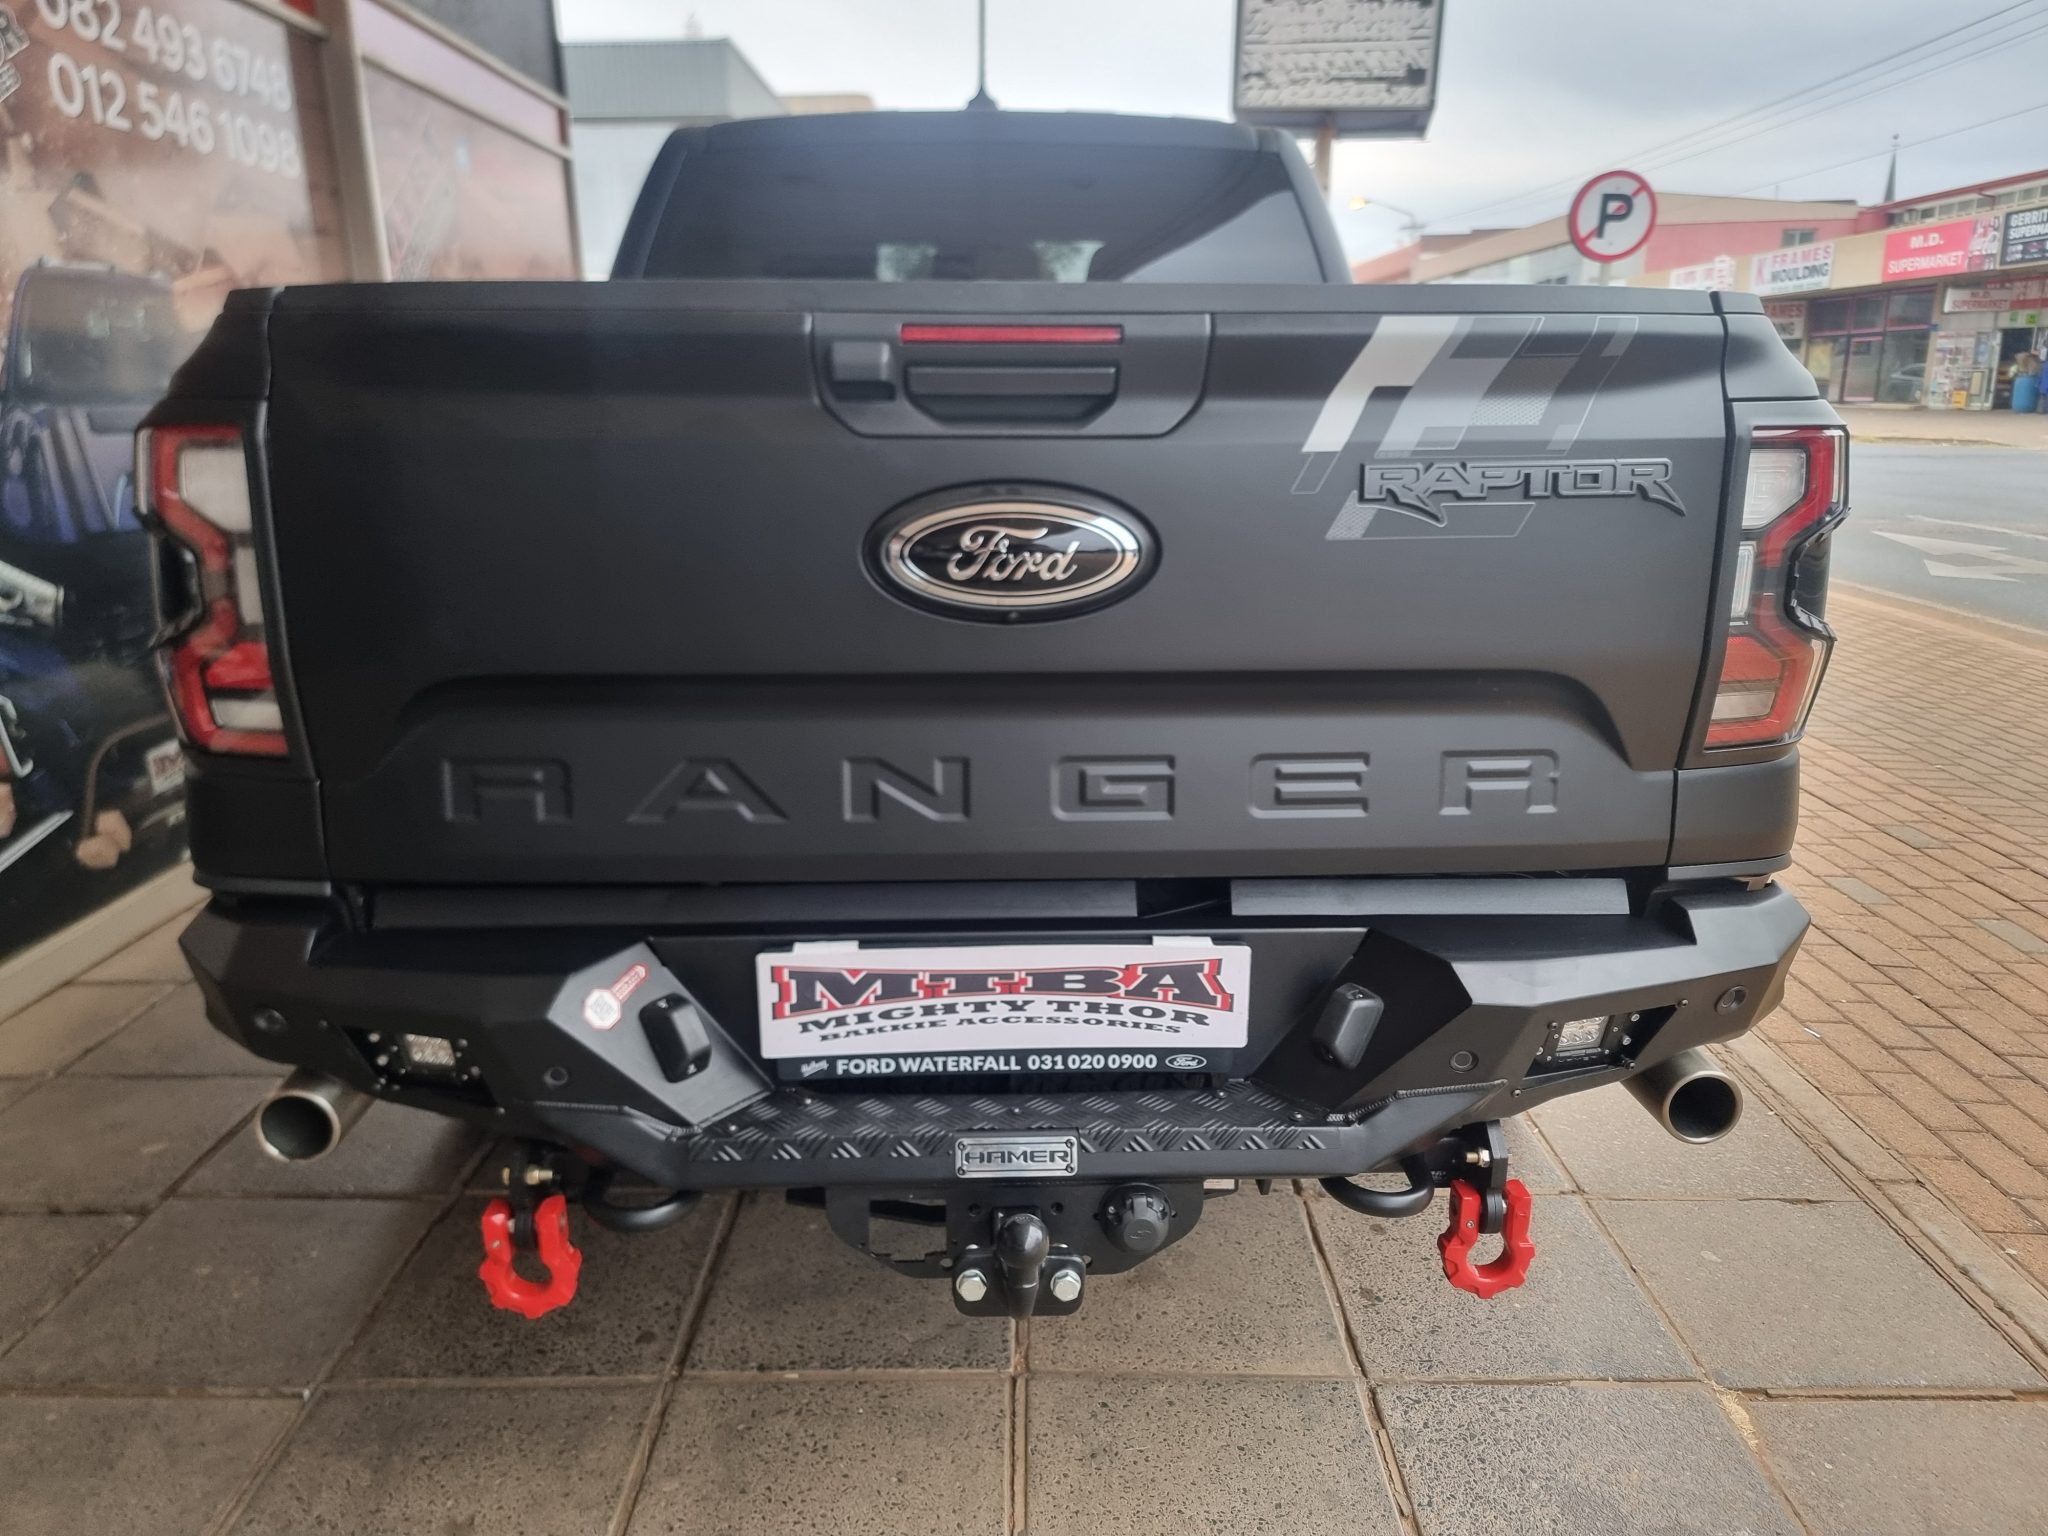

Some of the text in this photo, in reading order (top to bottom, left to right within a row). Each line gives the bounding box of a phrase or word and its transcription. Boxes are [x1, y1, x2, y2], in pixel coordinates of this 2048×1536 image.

[132, 5, 208, 81] 493
[212, 37, 293, 113] 6748
[47, 51, 133, 130] 012
[136, 80, 215, 155] 546
[218, 110, 300, 180] 1098
[1595, 193, 1634, 239] P
[1771, 244, 1832, 267] FRAMES
[1909, 232, 1944, 249] M.D.
[1771, 262, 1830, 283] MOULDING
[1887, 251, 1966, 274] SUPERMARKET
[1358, 458, 1687, 528] RAPTOR
[946, 524, 1079, 581] Ford
[441, 748, 1561, 823] RANGER
[798, 999, 1210, 1034] MIGHTY THOR
[819, 1015, 1182, 1042] BAKKIE ACCESSORIES
[836, 1058, 896, 1076] FORD
[898, 1055, 1022, 1074] WATERFALL
[1027, 1054, 1065, 1071] 031
[1067, 1053, 1105, 1070] 020
[1107, 1053, 1158, 1070] 0900
[964, 1149, 1071, 1165] HAMER
